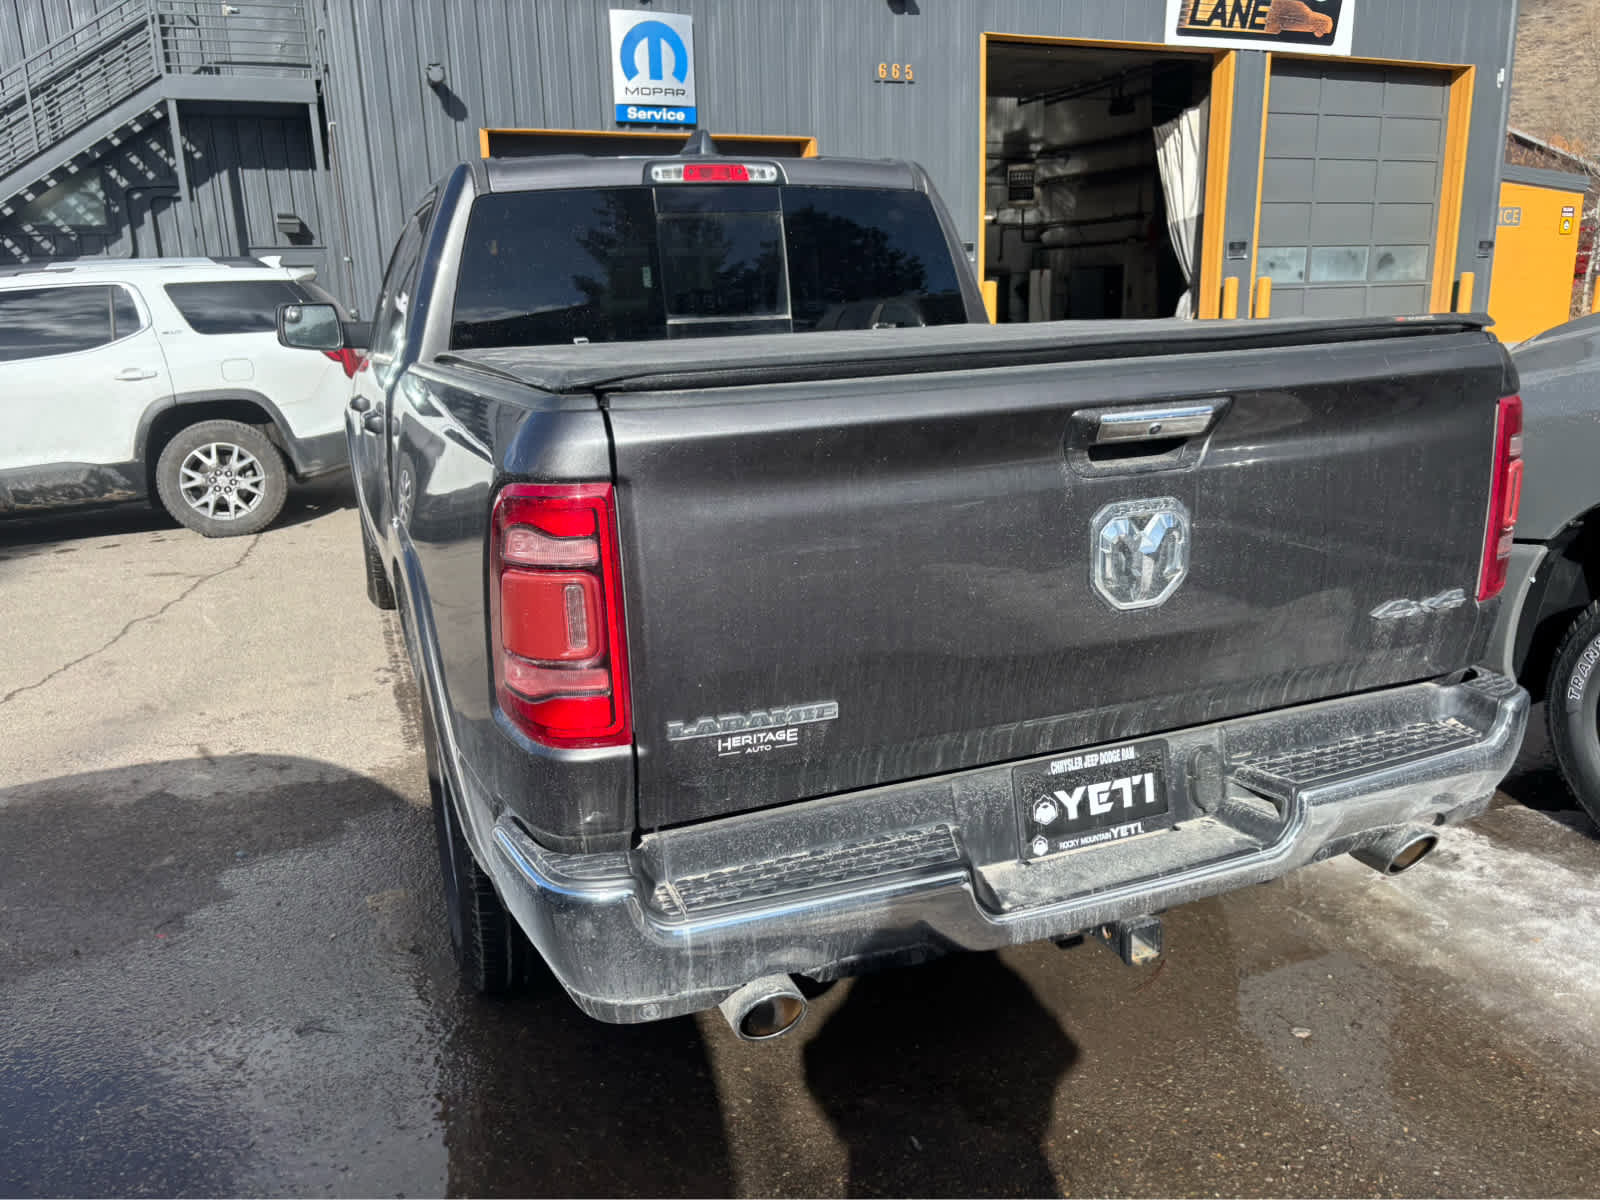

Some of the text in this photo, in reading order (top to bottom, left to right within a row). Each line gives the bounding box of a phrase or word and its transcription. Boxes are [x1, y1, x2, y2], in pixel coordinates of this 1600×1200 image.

[1188, 0, 1267, 32] LANE
[878, 63, 913, 80] 665
[625, 86, 688, 97] MOPAR
[627, 106, 686, 121] Service
[717, 728, 799, 752] HERITAGE
[745, 744, 773, 754] AUTO
[1050, 745, 1135, 775] CHRYSLER JEEP DODGE RAM
[1053, 772, 1155, 821] YETI
[1059, 821, 1144, 850] ROCKY MOUNTAIN YETI
